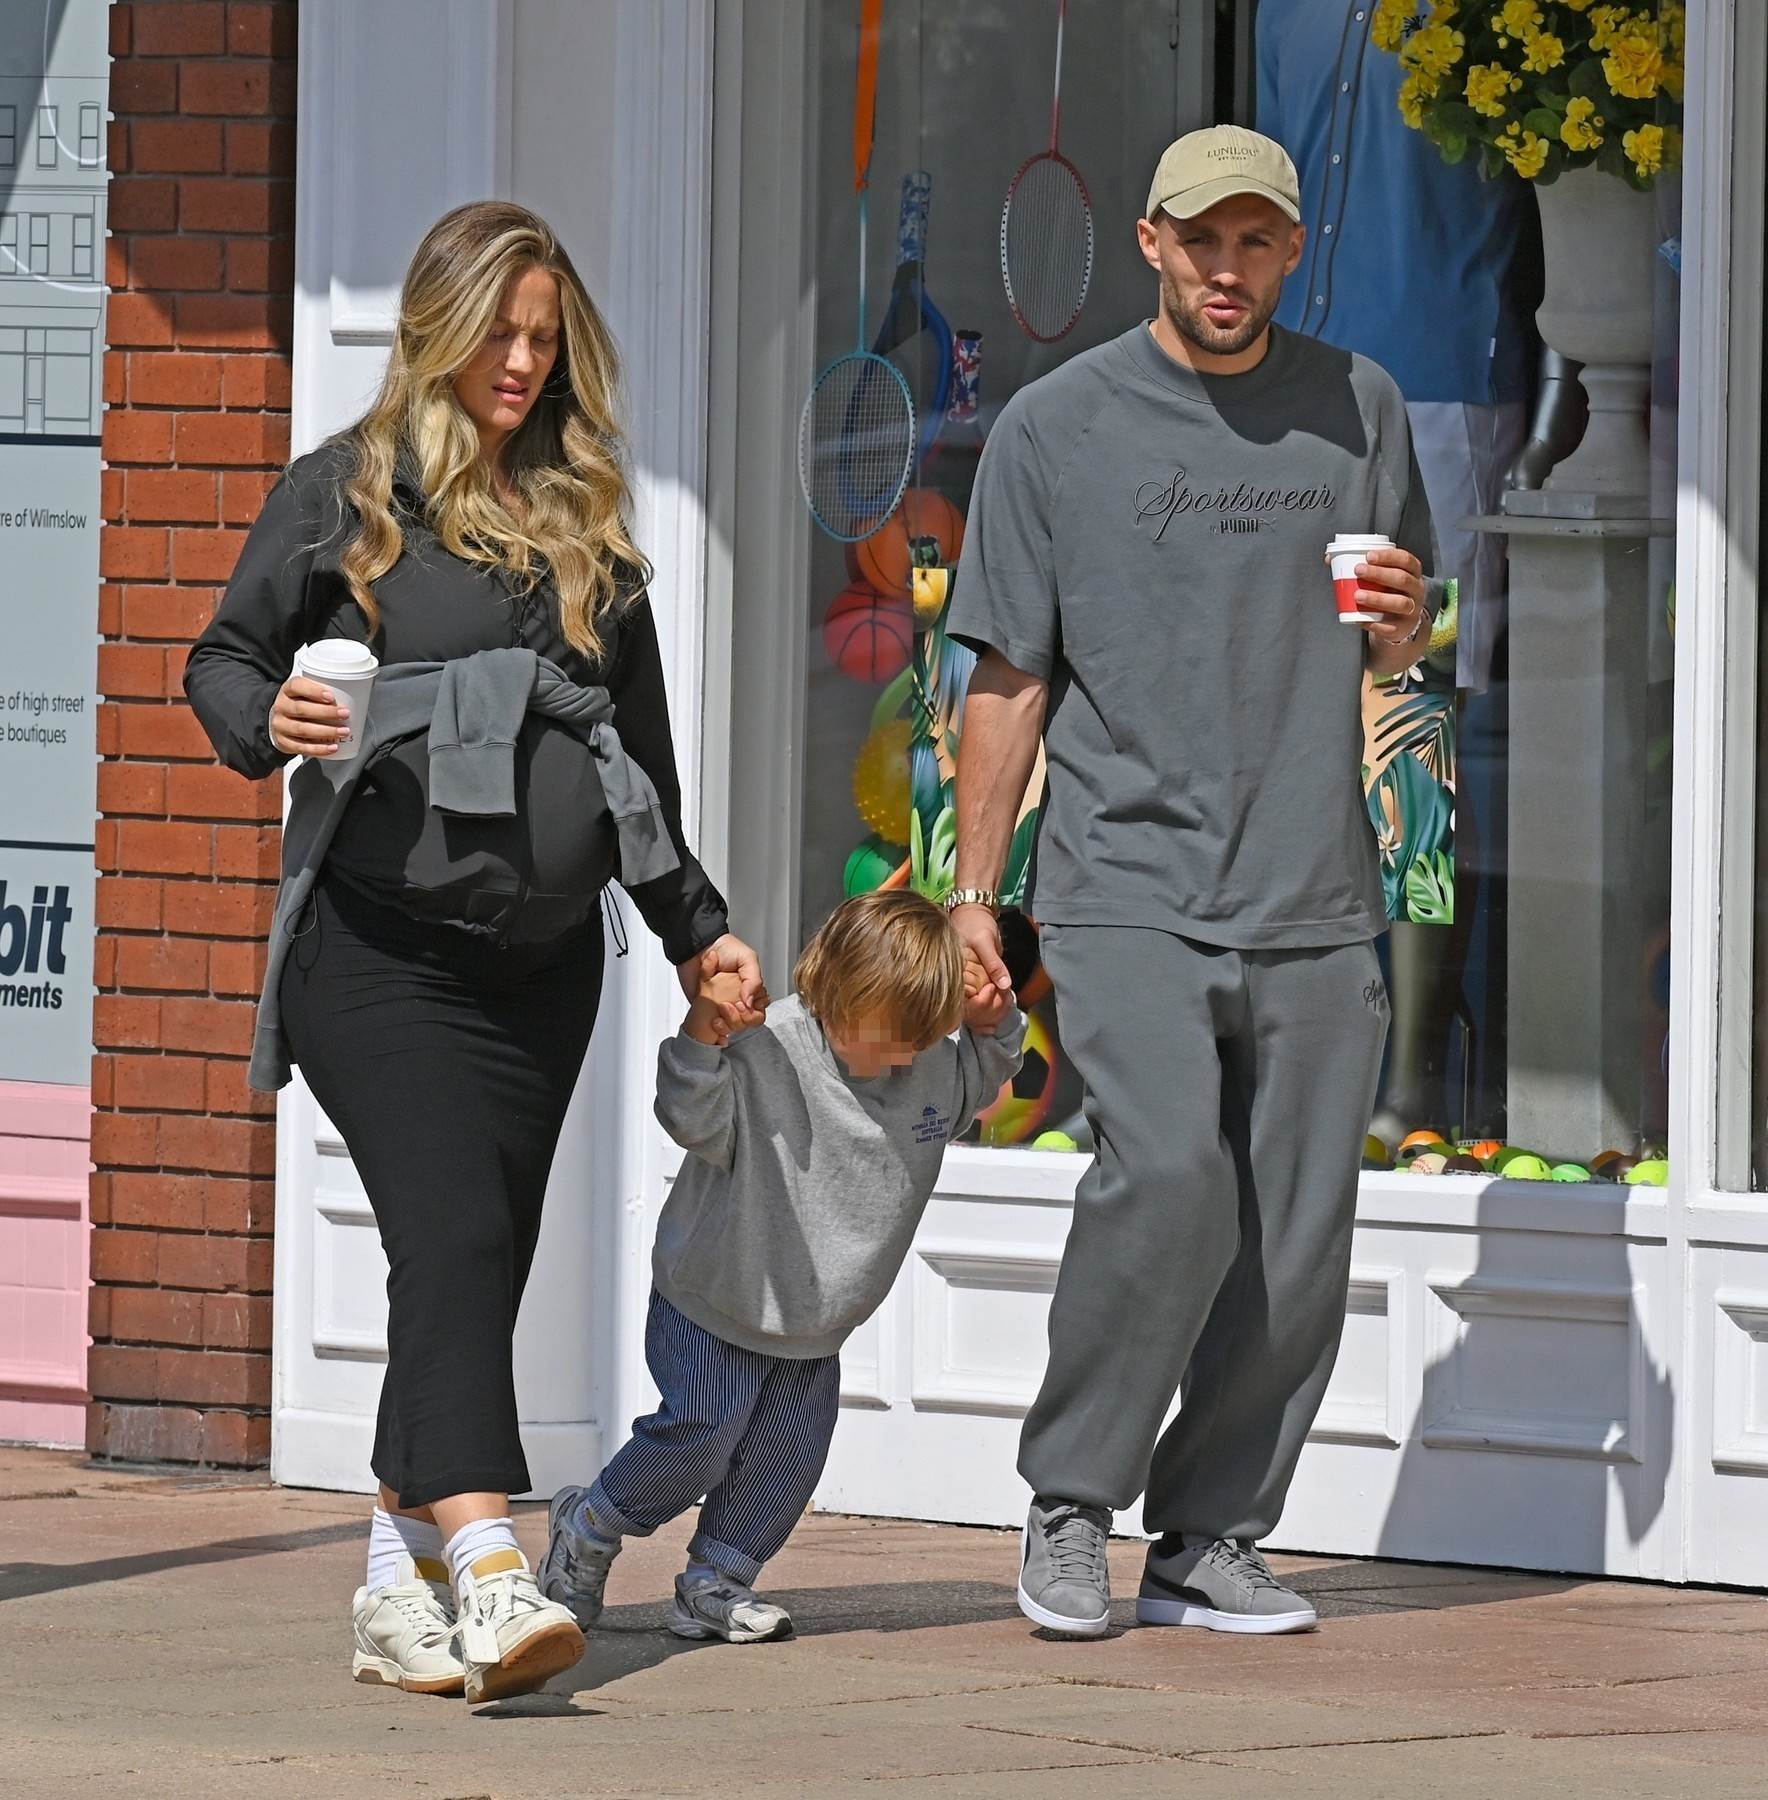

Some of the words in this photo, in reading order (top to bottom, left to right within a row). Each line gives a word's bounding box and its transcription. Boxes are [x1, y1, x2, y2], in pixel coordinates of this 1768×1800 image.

[0, 512, 12, 527] re
[15, 508, 28, 527] of
[29, 508, 87, 528] Wilmslow
[1134, 469, 1335, 542] Sportswear
[1220, 518, 1259, 534] PUMA
[8, 691, 21, 710] of
[23, 691, 49, 716] high
[52, 694, 84, 713] street
[8, 722, 67, 748] boutiques
[0, 981, 63, 1010] ments
